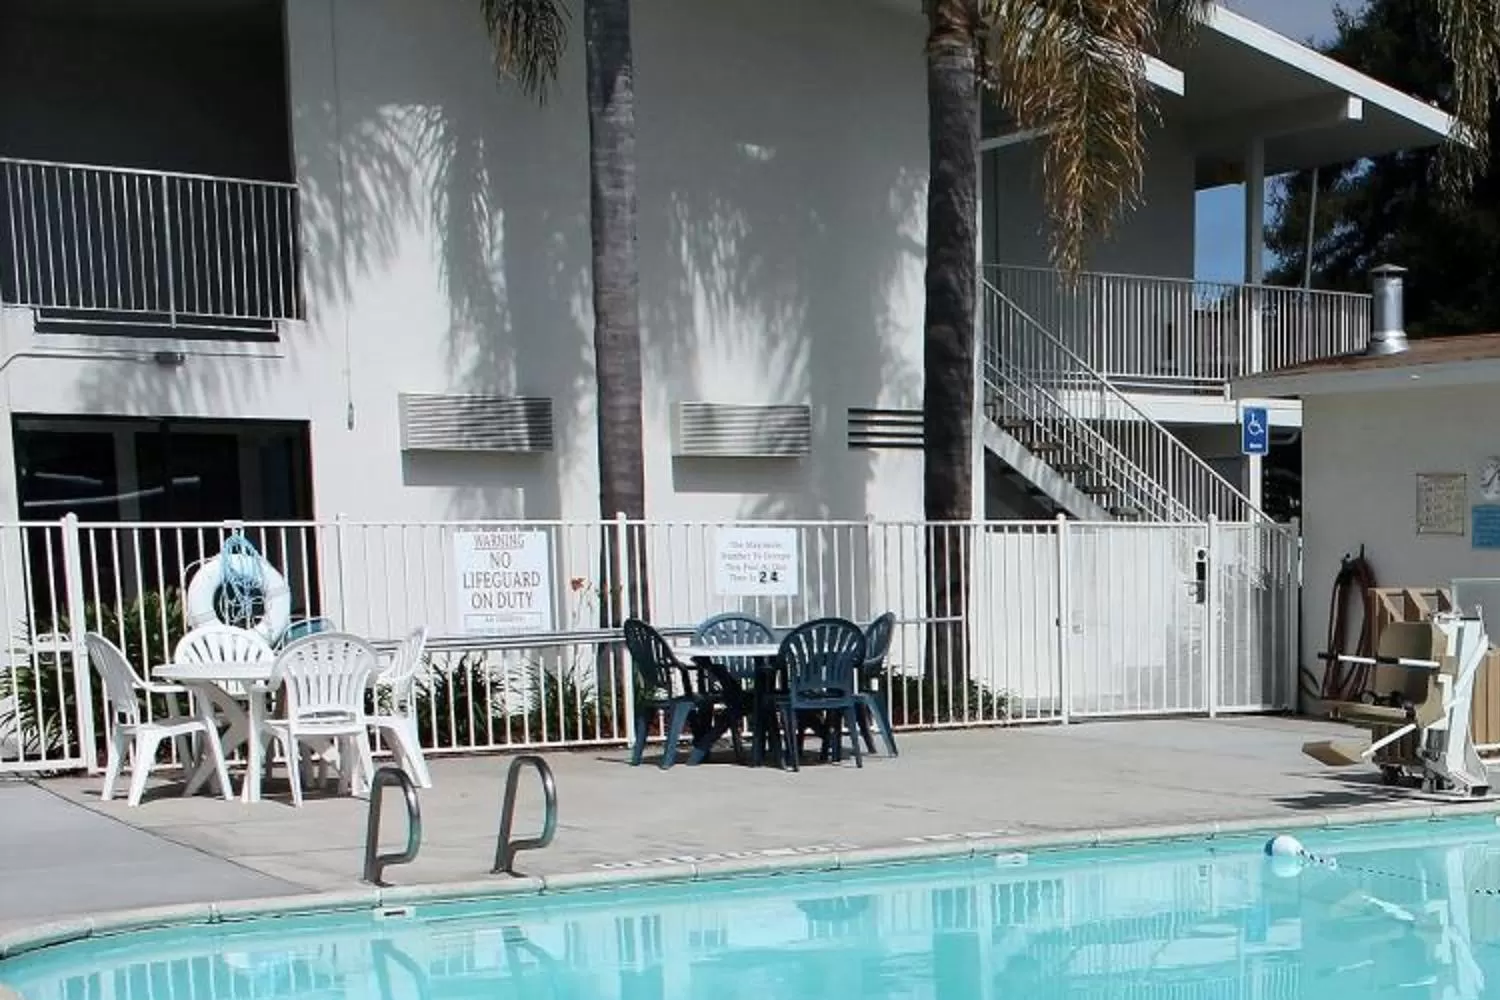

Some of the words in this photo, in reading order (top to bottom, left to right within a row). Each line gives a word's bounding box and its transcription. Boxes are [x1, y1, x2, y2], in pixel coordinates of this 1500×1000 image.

[473, 533, 525, 550] WARNING
[490, 552, 511, 568] NO
[463, 571, 541, 589] LIFEGUARD
[471, 592, 493, 609] ON
[497, 592, 533, 609] DUTY
